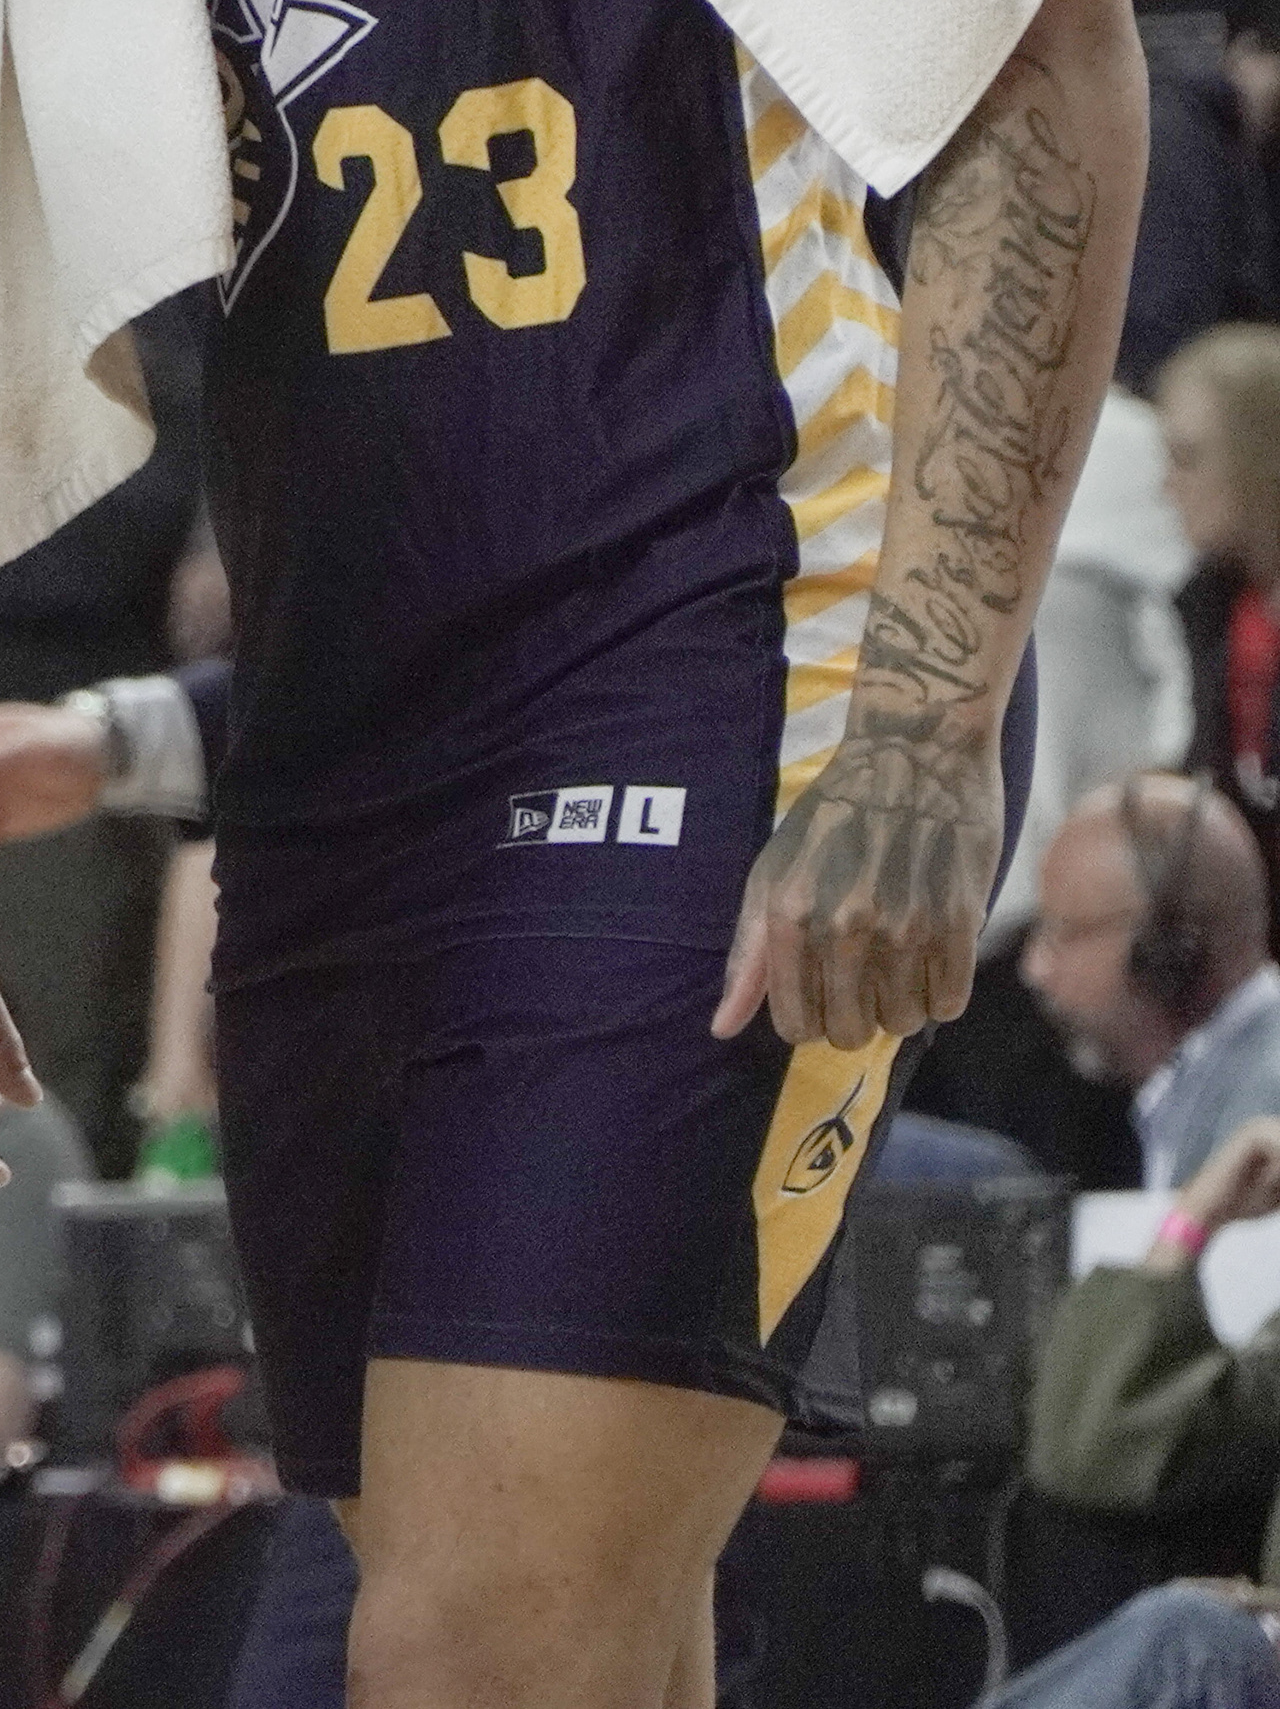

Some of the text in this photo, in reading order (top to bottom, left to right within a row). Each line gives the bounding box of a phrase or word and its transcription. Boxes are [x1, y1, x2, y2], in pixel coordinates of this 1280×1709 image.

[312, 76, 587, 355] 23
[562, 798, 604, 816] NEW
[639, 796, 660, 835] L
[558, 814, 598, 830] ERA
